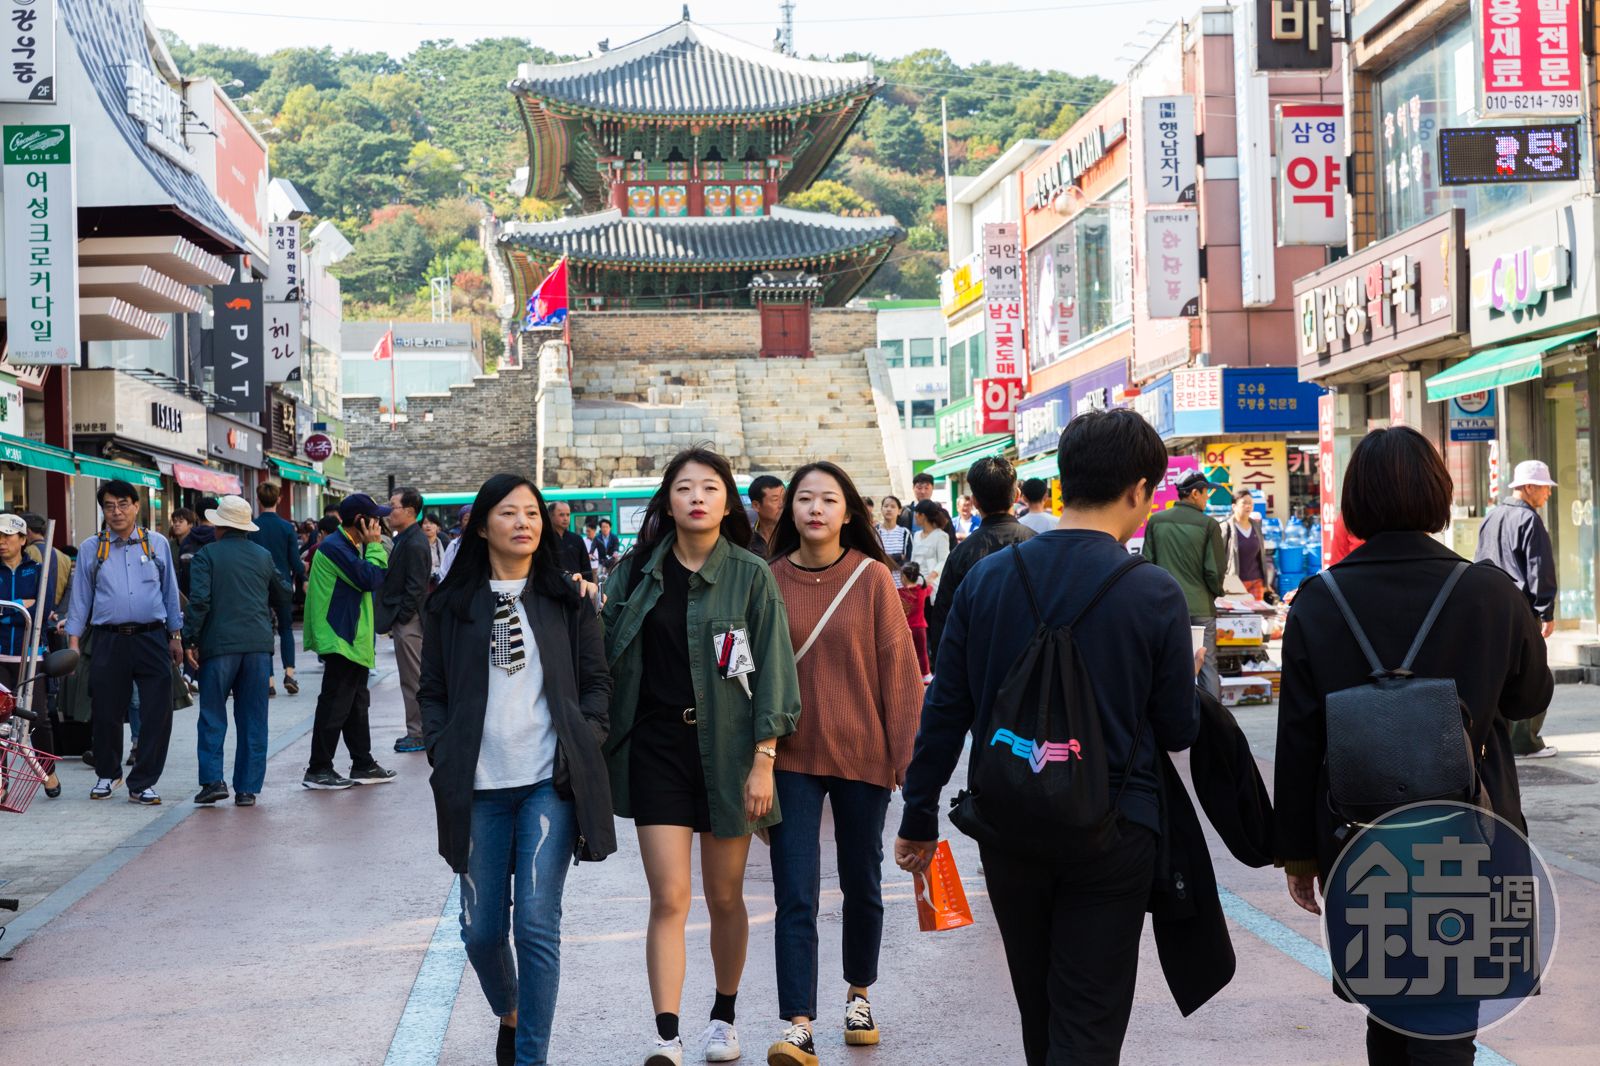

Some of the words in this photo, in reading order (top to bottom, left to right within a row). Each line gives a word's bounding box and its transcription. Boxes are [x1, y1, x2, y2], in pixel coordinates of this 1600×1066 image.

[1488, 0, 1523, 87] 용재료
[37, 85, 50, 97] 2F
[1486, 94, 1580, 110] 010-6214-7991
[1291, 122, 1336, 144] 삼영
[1159, 122, 1180, 192] 행남자기
[1184, 189, 1195, 200] 1F
[1287, 156, 1341, 218] 약
[26, 171, 54, 342] 여성크로커다일
[989, 244, 1016, 259] 리안
[989, 264, 1017, 279] 헤어
[1323, 254, 1408, 344] 삼영약국
[989, 303, 1020, 319] 남신
[1187, 305, 1198, 315] 1F
[230, 324, 250, 397] PAT
[985, 381, 1021, 431] 약
[1269, 398, 1297, 410] 전문점
[1457, 419, 1489, 429] KTRA
[1321, 403, 1337, 570] 삼영약
